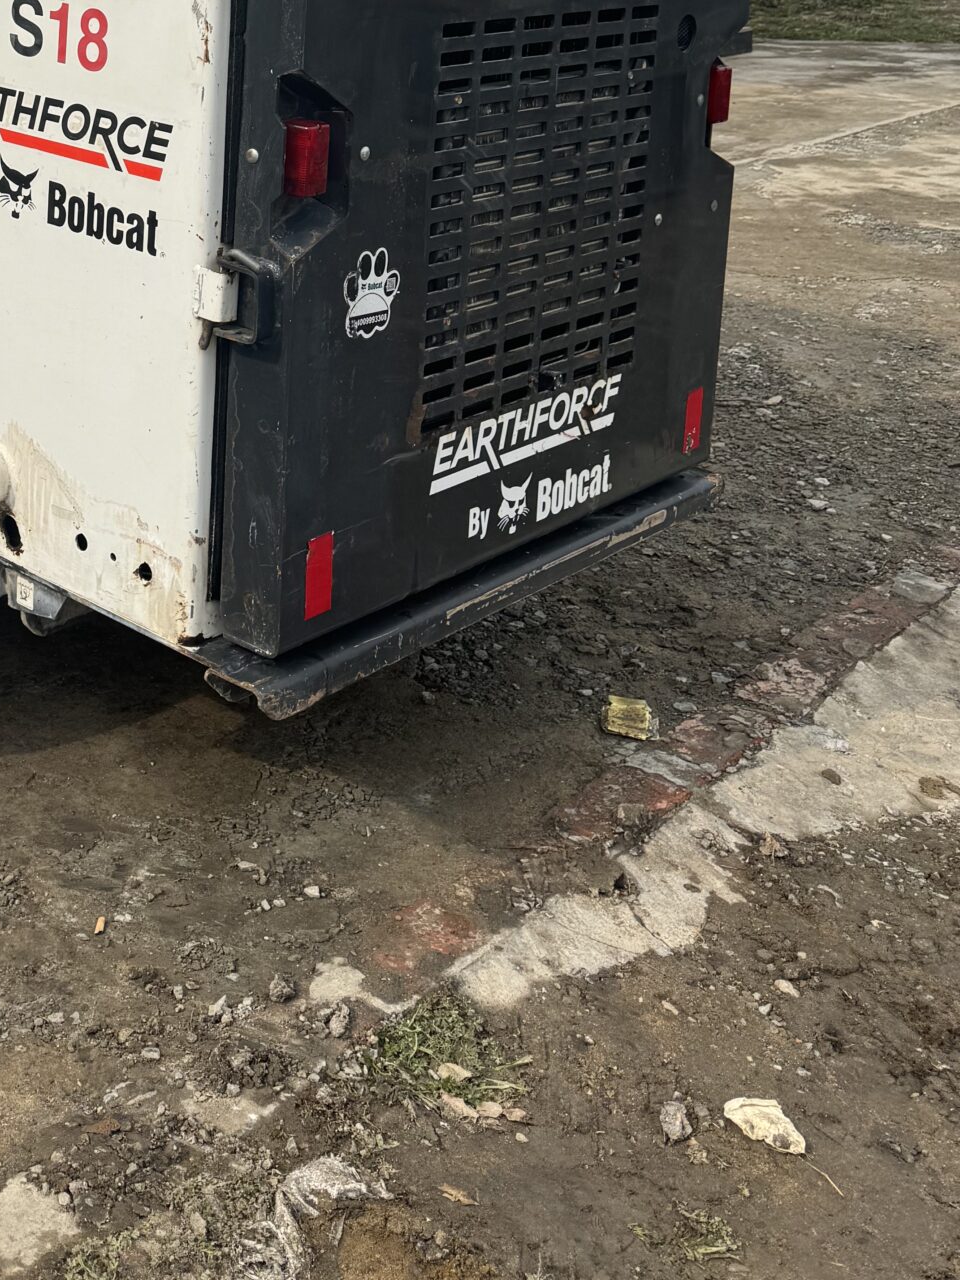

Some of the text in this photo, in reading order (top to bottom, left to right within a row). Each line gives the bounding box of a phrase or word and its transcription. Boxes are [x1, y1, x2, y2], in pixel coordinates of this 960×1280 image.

[46, 180, 159, 257] Bobcat
[467, 453, 611, 540] By Bobcat
